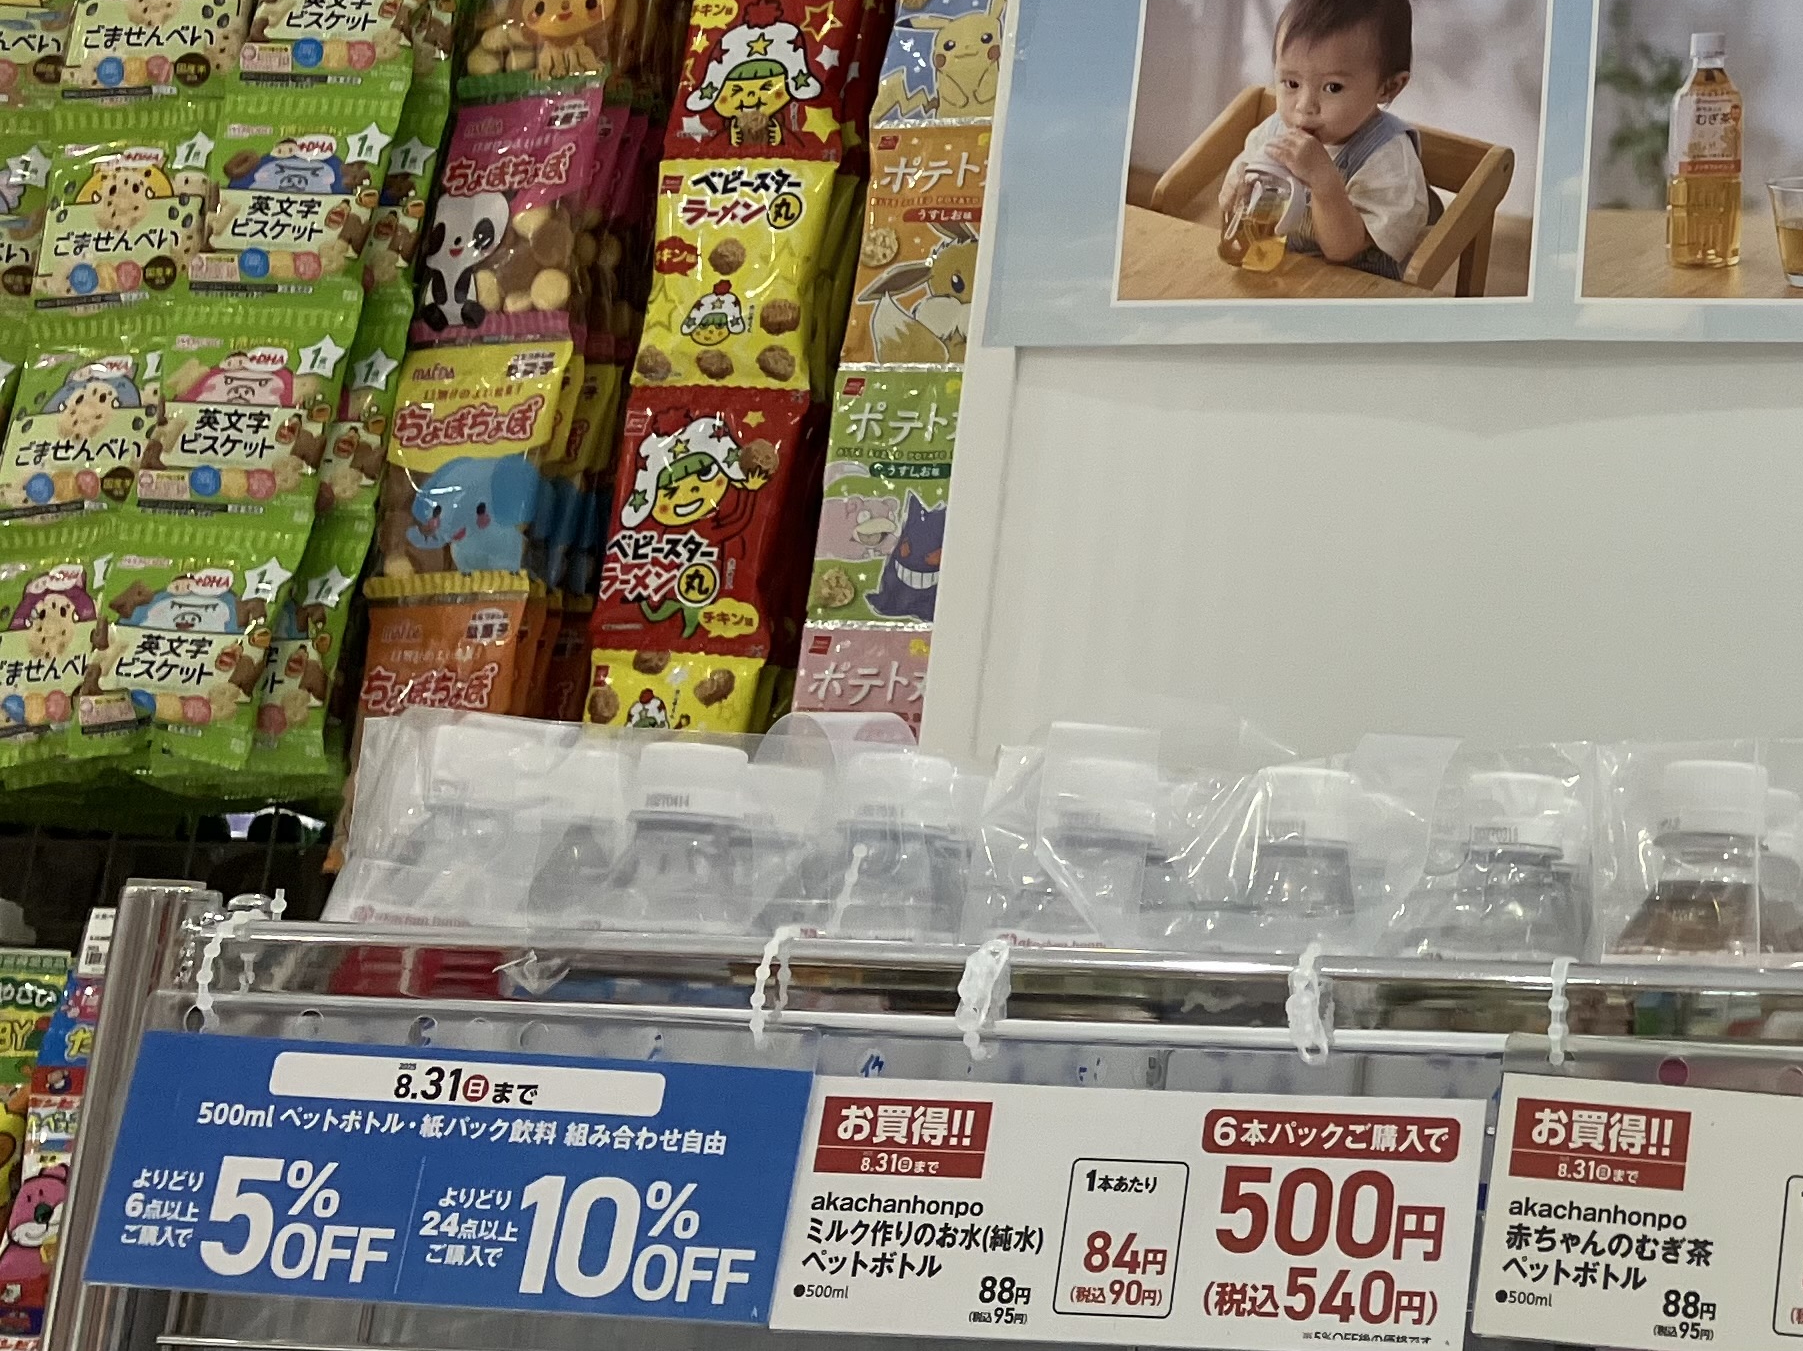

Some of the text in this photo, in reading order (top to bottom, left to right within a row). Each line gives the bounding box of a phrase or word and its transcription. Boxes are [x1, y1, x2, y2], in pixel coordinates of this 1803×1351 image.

[84, 24, 214, 48] ごませんべい
[287, 11, 377, 31] ビスケット
[691, 167, 802, 195] ベビースター
[880, 152, 988, 194] ポテト
[247, 195, 321, 219] 英文字
[53, 229, 179, 256] ごませんべい
[230, 217, 323, 242] ビスケット
[195, 409, 270, 434] 英文字
[846, 401, 958, 445] ポテト
[16, 439, 141, 466] ごませんべい
[180, 434, 275, 459] ビスケット
[607, 529, 719, 564] ベビースター
[137, 634, 213, 657] 英文字
[115, 657, 213, 685] ビスケット
[197, 1101, 726, 1156] 500ml ペットボトル・紙パック飲料 組み合わせ自由
[838, 1102, 973, 1147] お買得!!
[1213, 1116, 1450, 1156] 6本パックご購入で
[1531, 1107, 1672, 1158] お買得!!
[132, 1167, 204, 1194] よりどり
[1085, 1170, 1158, 1195] 1本あたり
[124, 1193, 199, 1224] 6点以上
[438, 1186, 512, 1211] よりどり
[811, 1194, 984, 1219] akachanhonpo
[1215, 1165, 1445, 1262] 500円
[419, 1208, 518, 1243] 24点以上
[1508, 1199, 1687, 1232] akachanhonpo
[120, 1223, 192, 1249] ご購入で
[807, 1219, 1044, 1254] ミルク作りのお水(純水)
[1506, 1225, 1714, 1267] 赤ちゃんのむぎ茶
[271, 1222, 395, 1283] OFF
[425, 1241, 503, 1268] ご購入で
[802, 1249, 942, 1280] ペットボトル
[1083, 1231, 1167, 1276] 84円
[632, 1246, 755, 1305] OFF
[1503, 1257, 1647, 1291] ペットボトル
[979, 1276, 1031, 1306] 88円
[1070, 1279, 1163, 1309] (税込90円)
[1203, 1268, 1437, 1327] (税込540円)
[1662, 1288, 1716, 1322] 88円
